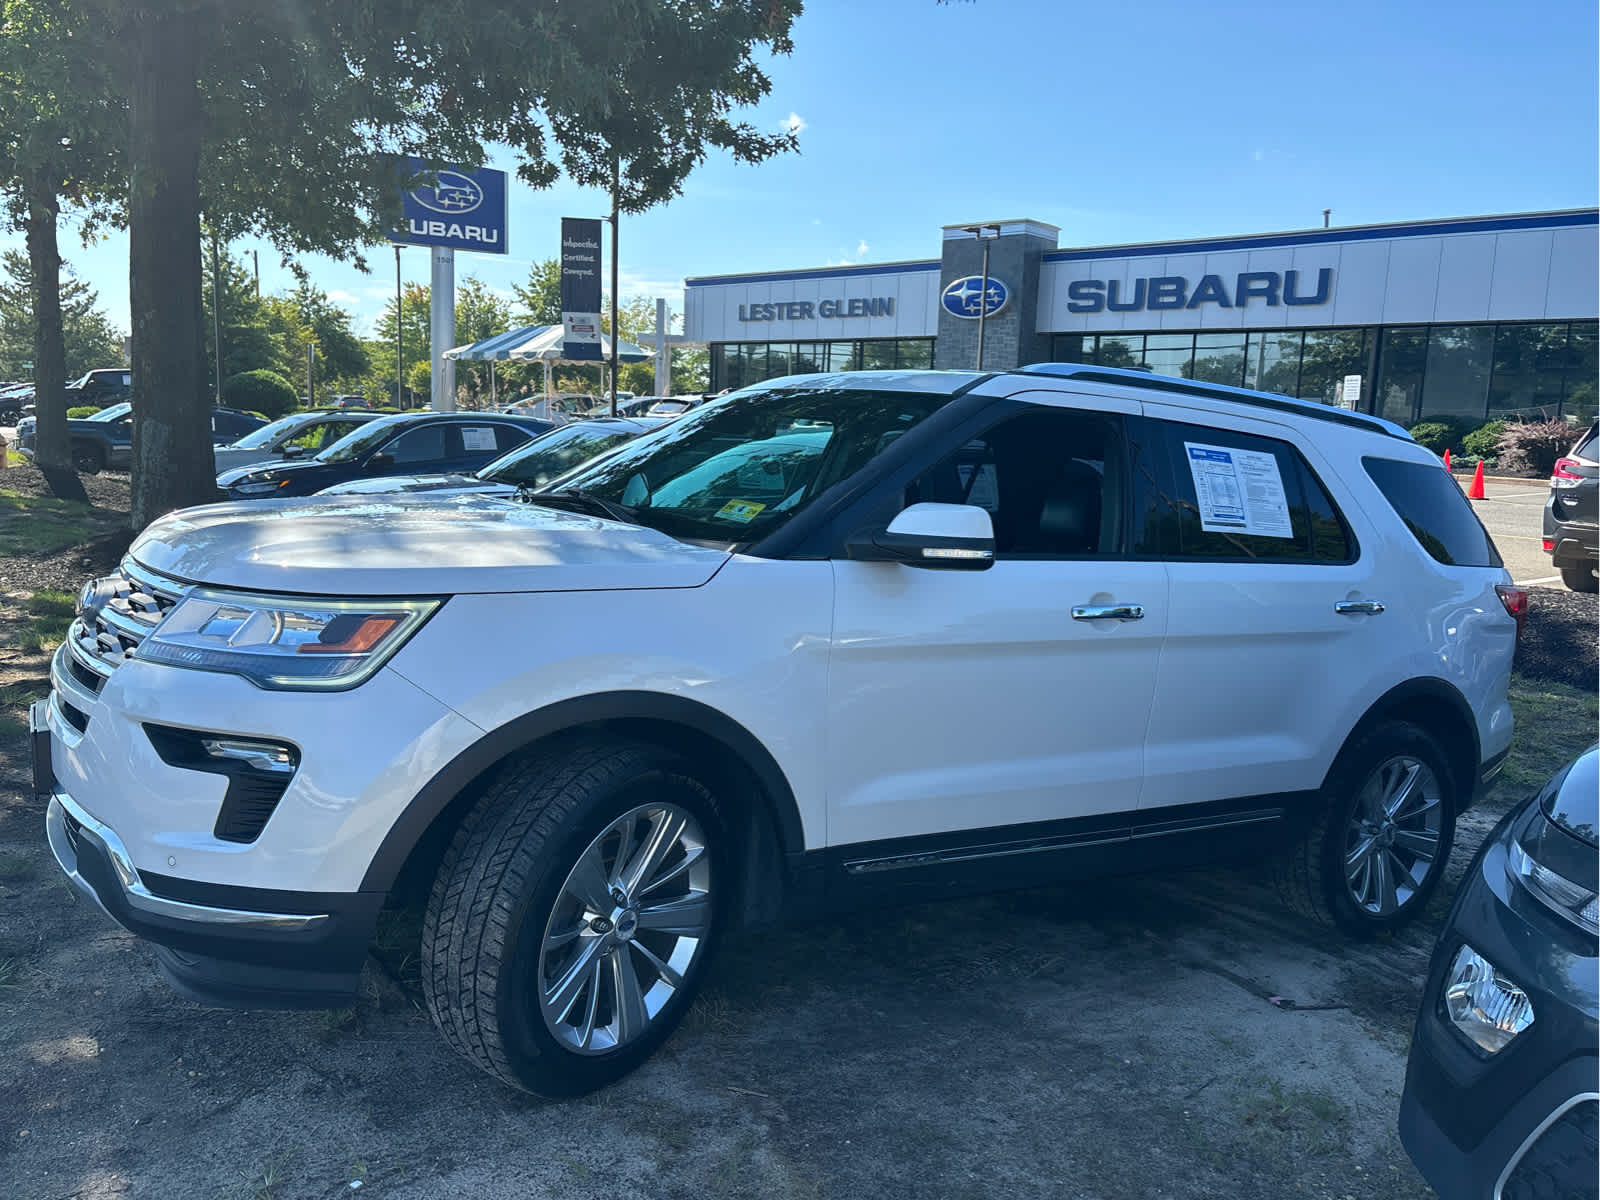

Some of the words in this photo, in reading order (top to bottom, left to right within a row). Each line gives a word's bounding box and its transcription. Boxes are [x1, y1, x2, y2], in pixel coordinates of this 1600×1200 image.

[1067, 268, 1332, 312] SUBARU
[738, 301, 816, 322] LESTER
[818, 297, 895, 319] GLENN
